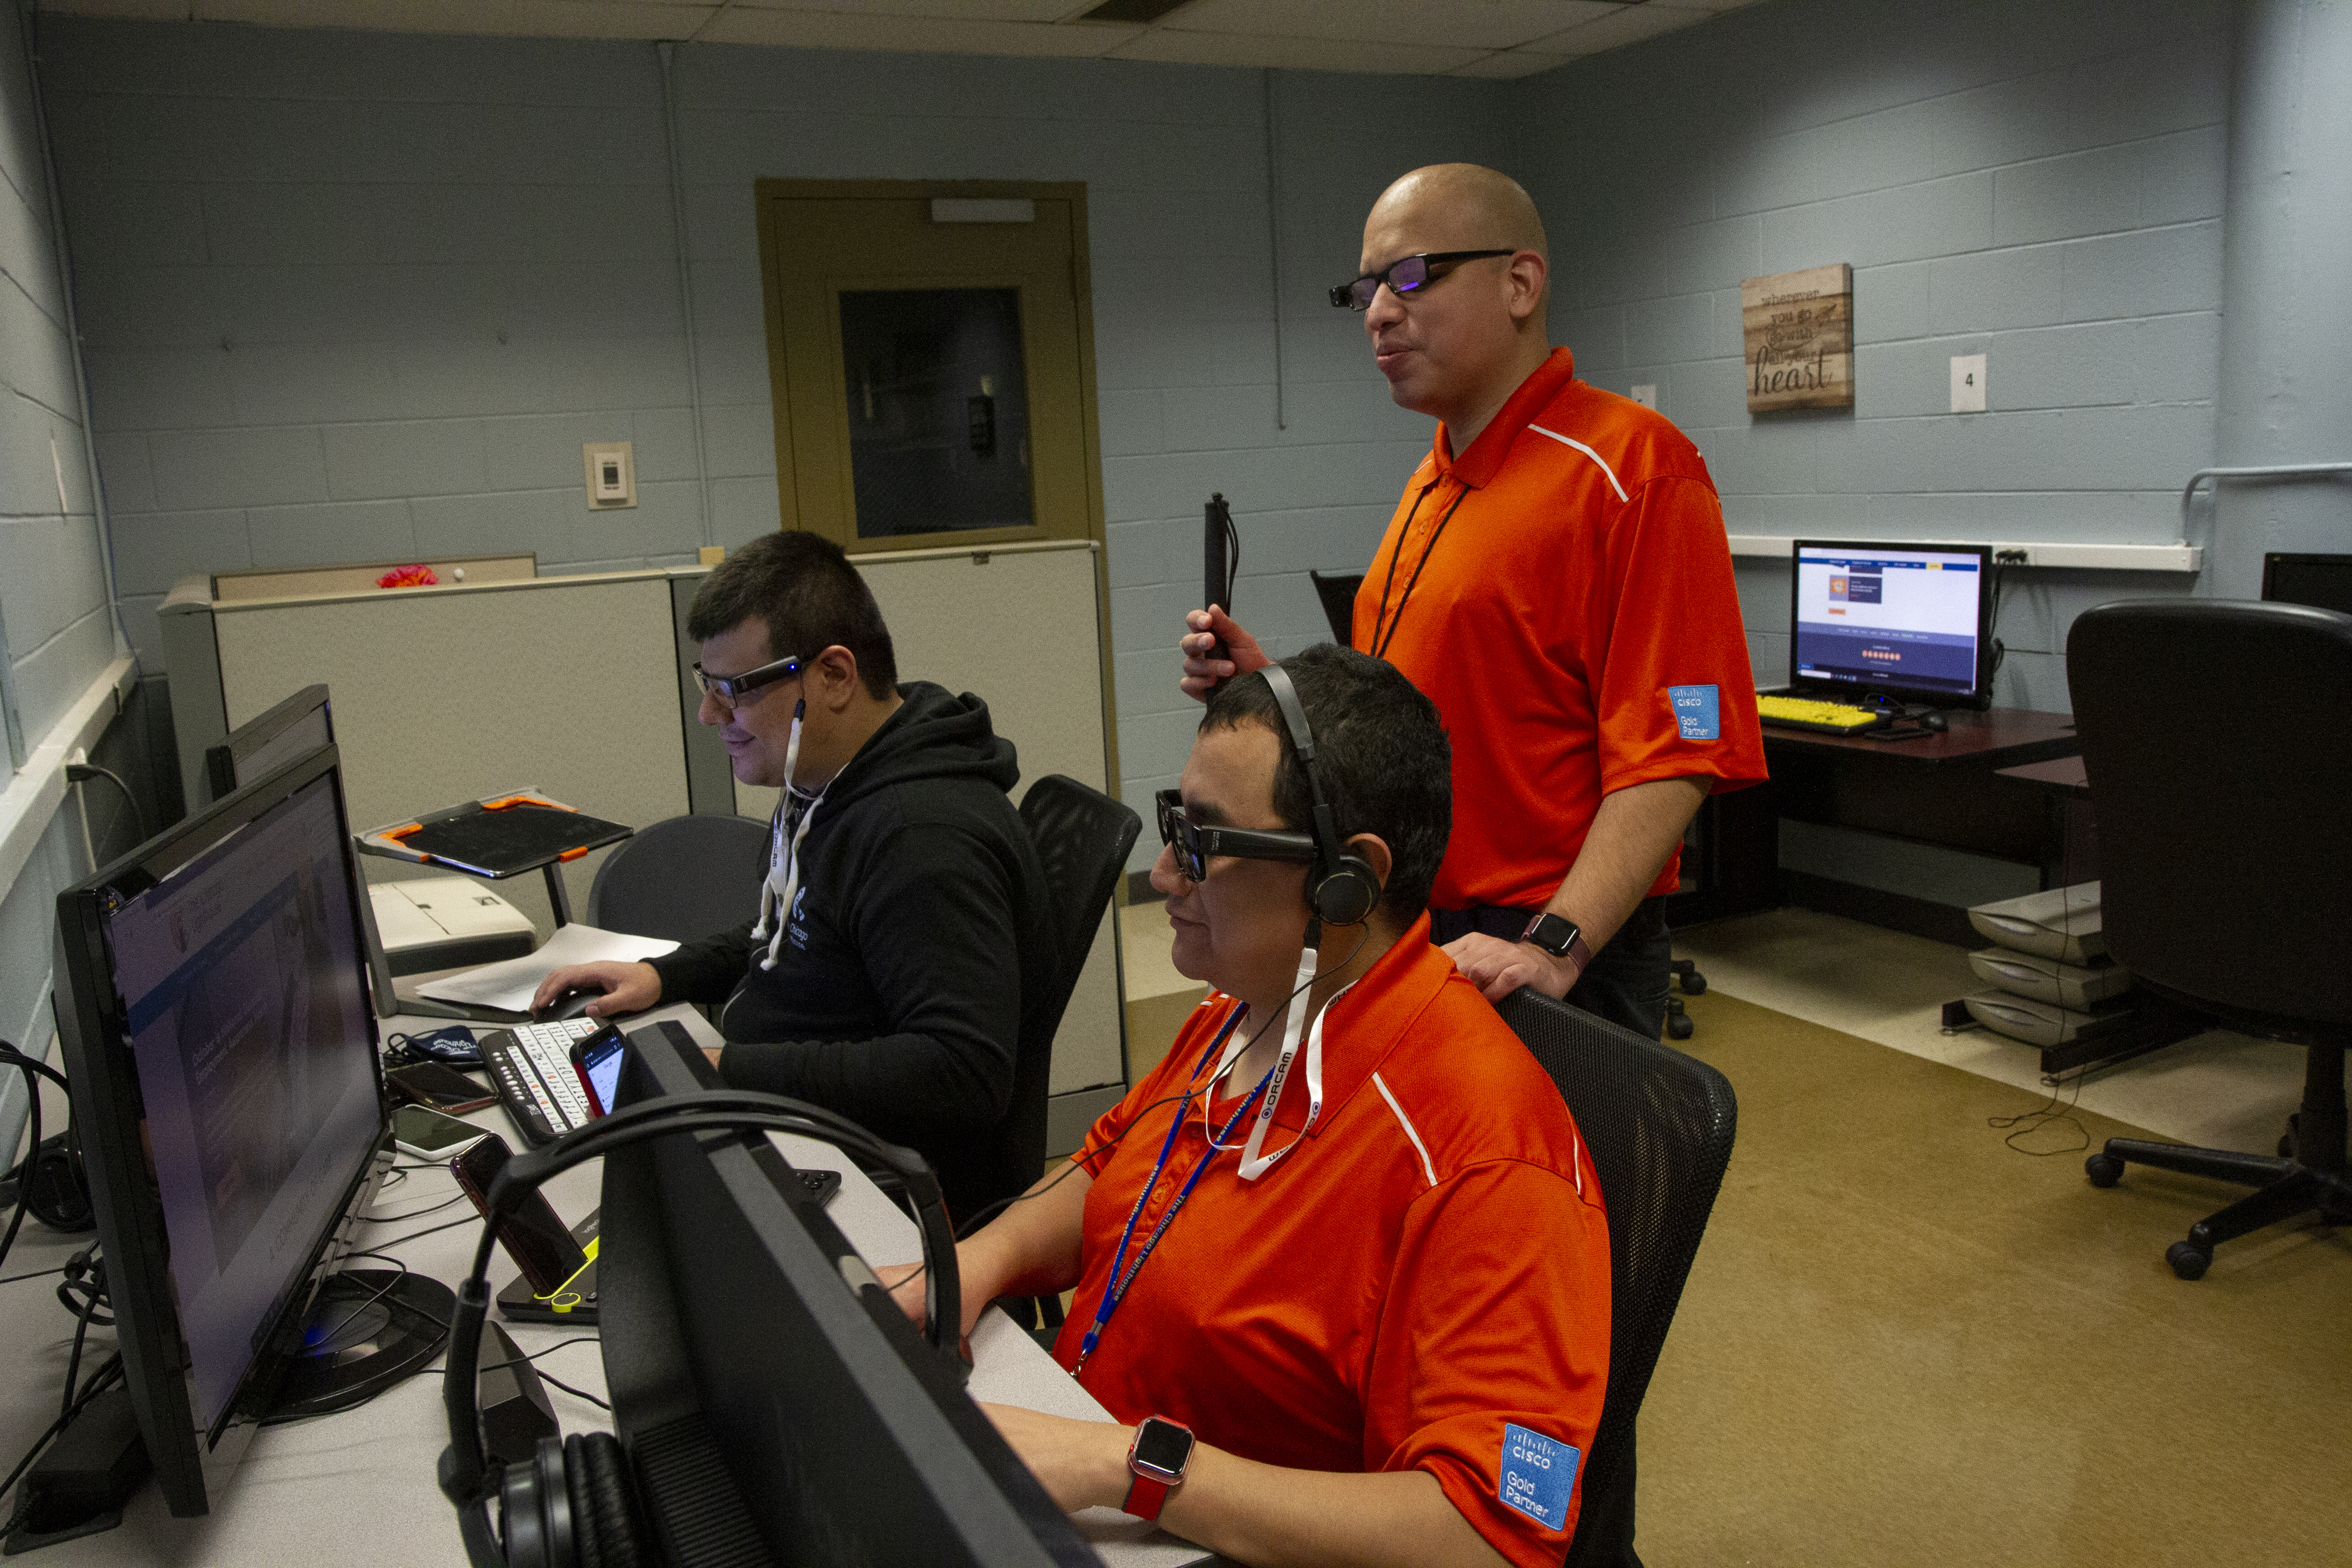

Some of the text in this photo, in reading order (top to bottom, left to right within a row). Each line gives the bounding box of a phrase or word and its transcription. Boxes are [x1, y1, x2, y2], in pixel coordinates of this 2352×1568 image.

[1771, 308, 1812, 325] you go
[1754, 345, 1833, 396] heart
[1965, 373, 1973, 387] 4
[1681, 716, 1698, 726] Gold
[1682, 726, 1709, 736] Partner
[790, 922, 808, 941] Chicago
[1267, 1051, 1292, 1106] ORCAM
[1171, 1194, 1186, 1212] The
[1146, 1212, 1173, 1250] Chicago
[1113, 1250, 1149, 1302] Lighthouse
[1507, 1471, 1535, 1495] Gold
[1506, 1485, 1548, 1517] Partner
